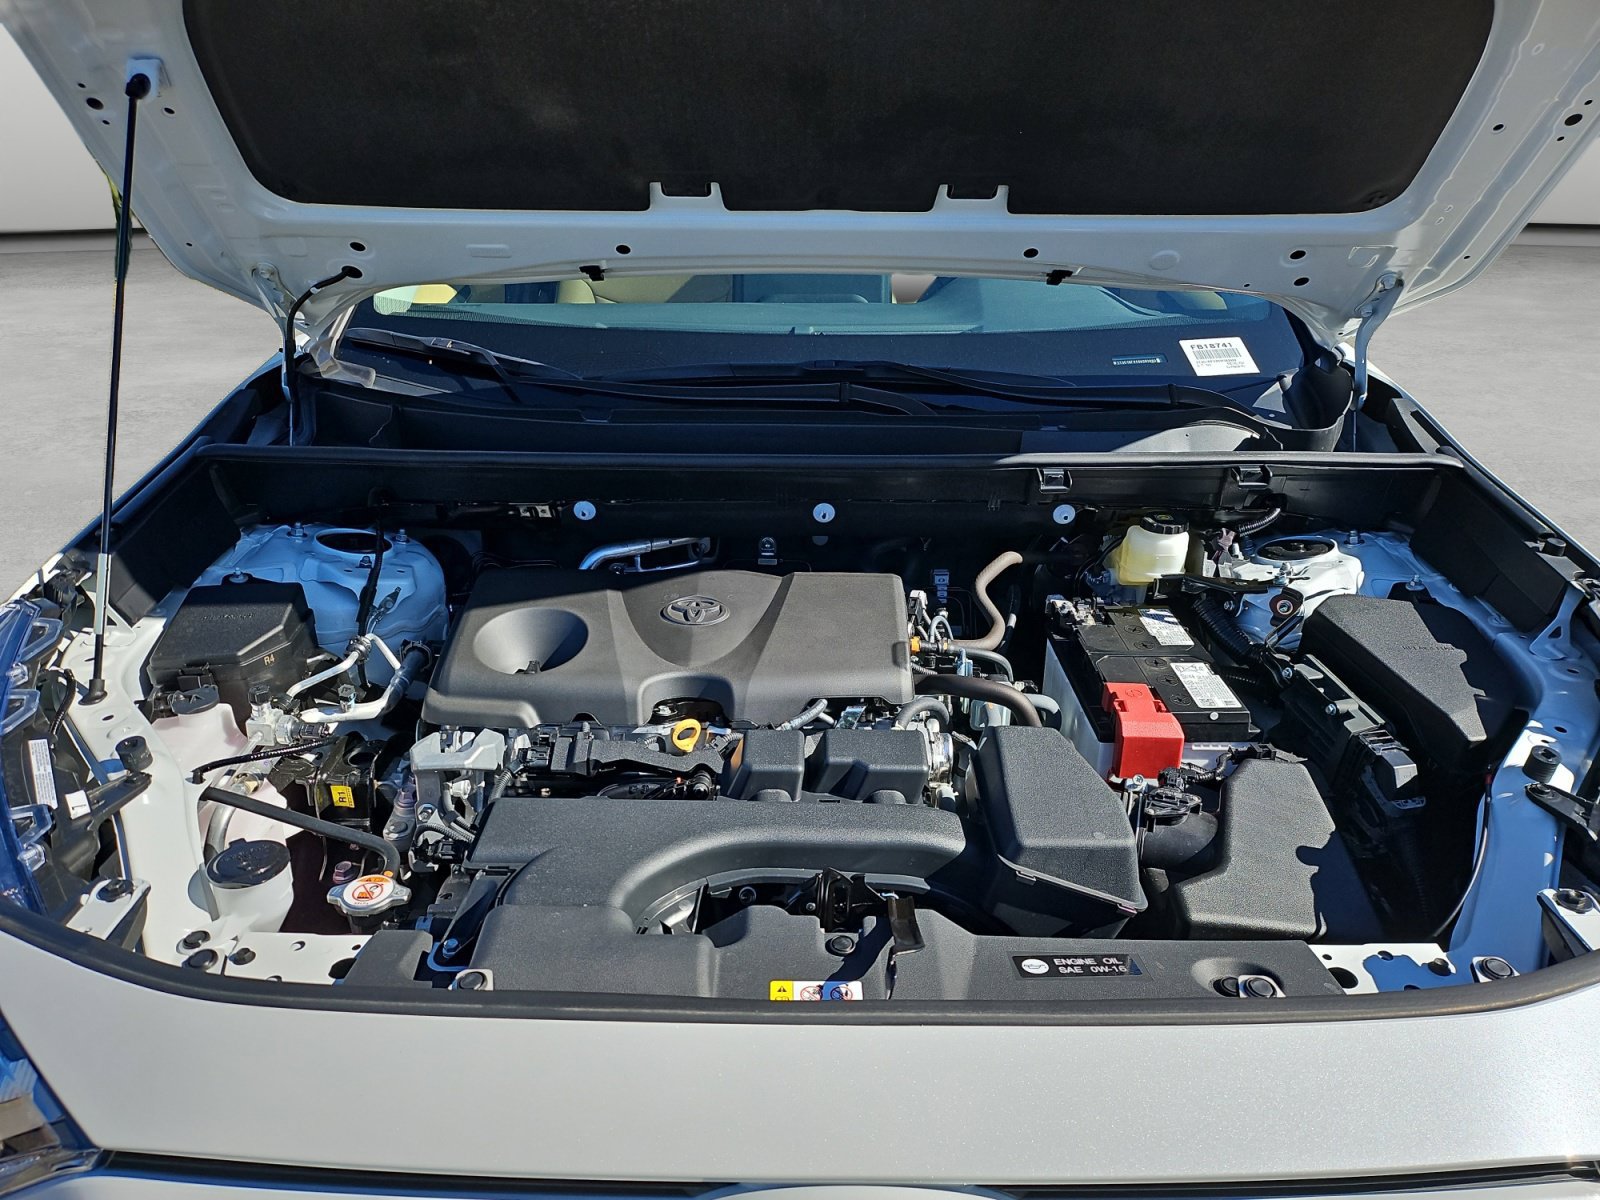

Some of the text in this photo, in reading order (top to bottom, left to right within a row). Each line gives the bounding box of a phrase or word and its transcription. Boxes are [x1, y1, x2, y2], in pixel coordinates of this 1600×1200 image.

[1190, 342, 1233, 350] FB18741
[1053, 957, 1123, 966] ENGINE OIL
[1058, 965, 1127, 974] SAE 0W-16
